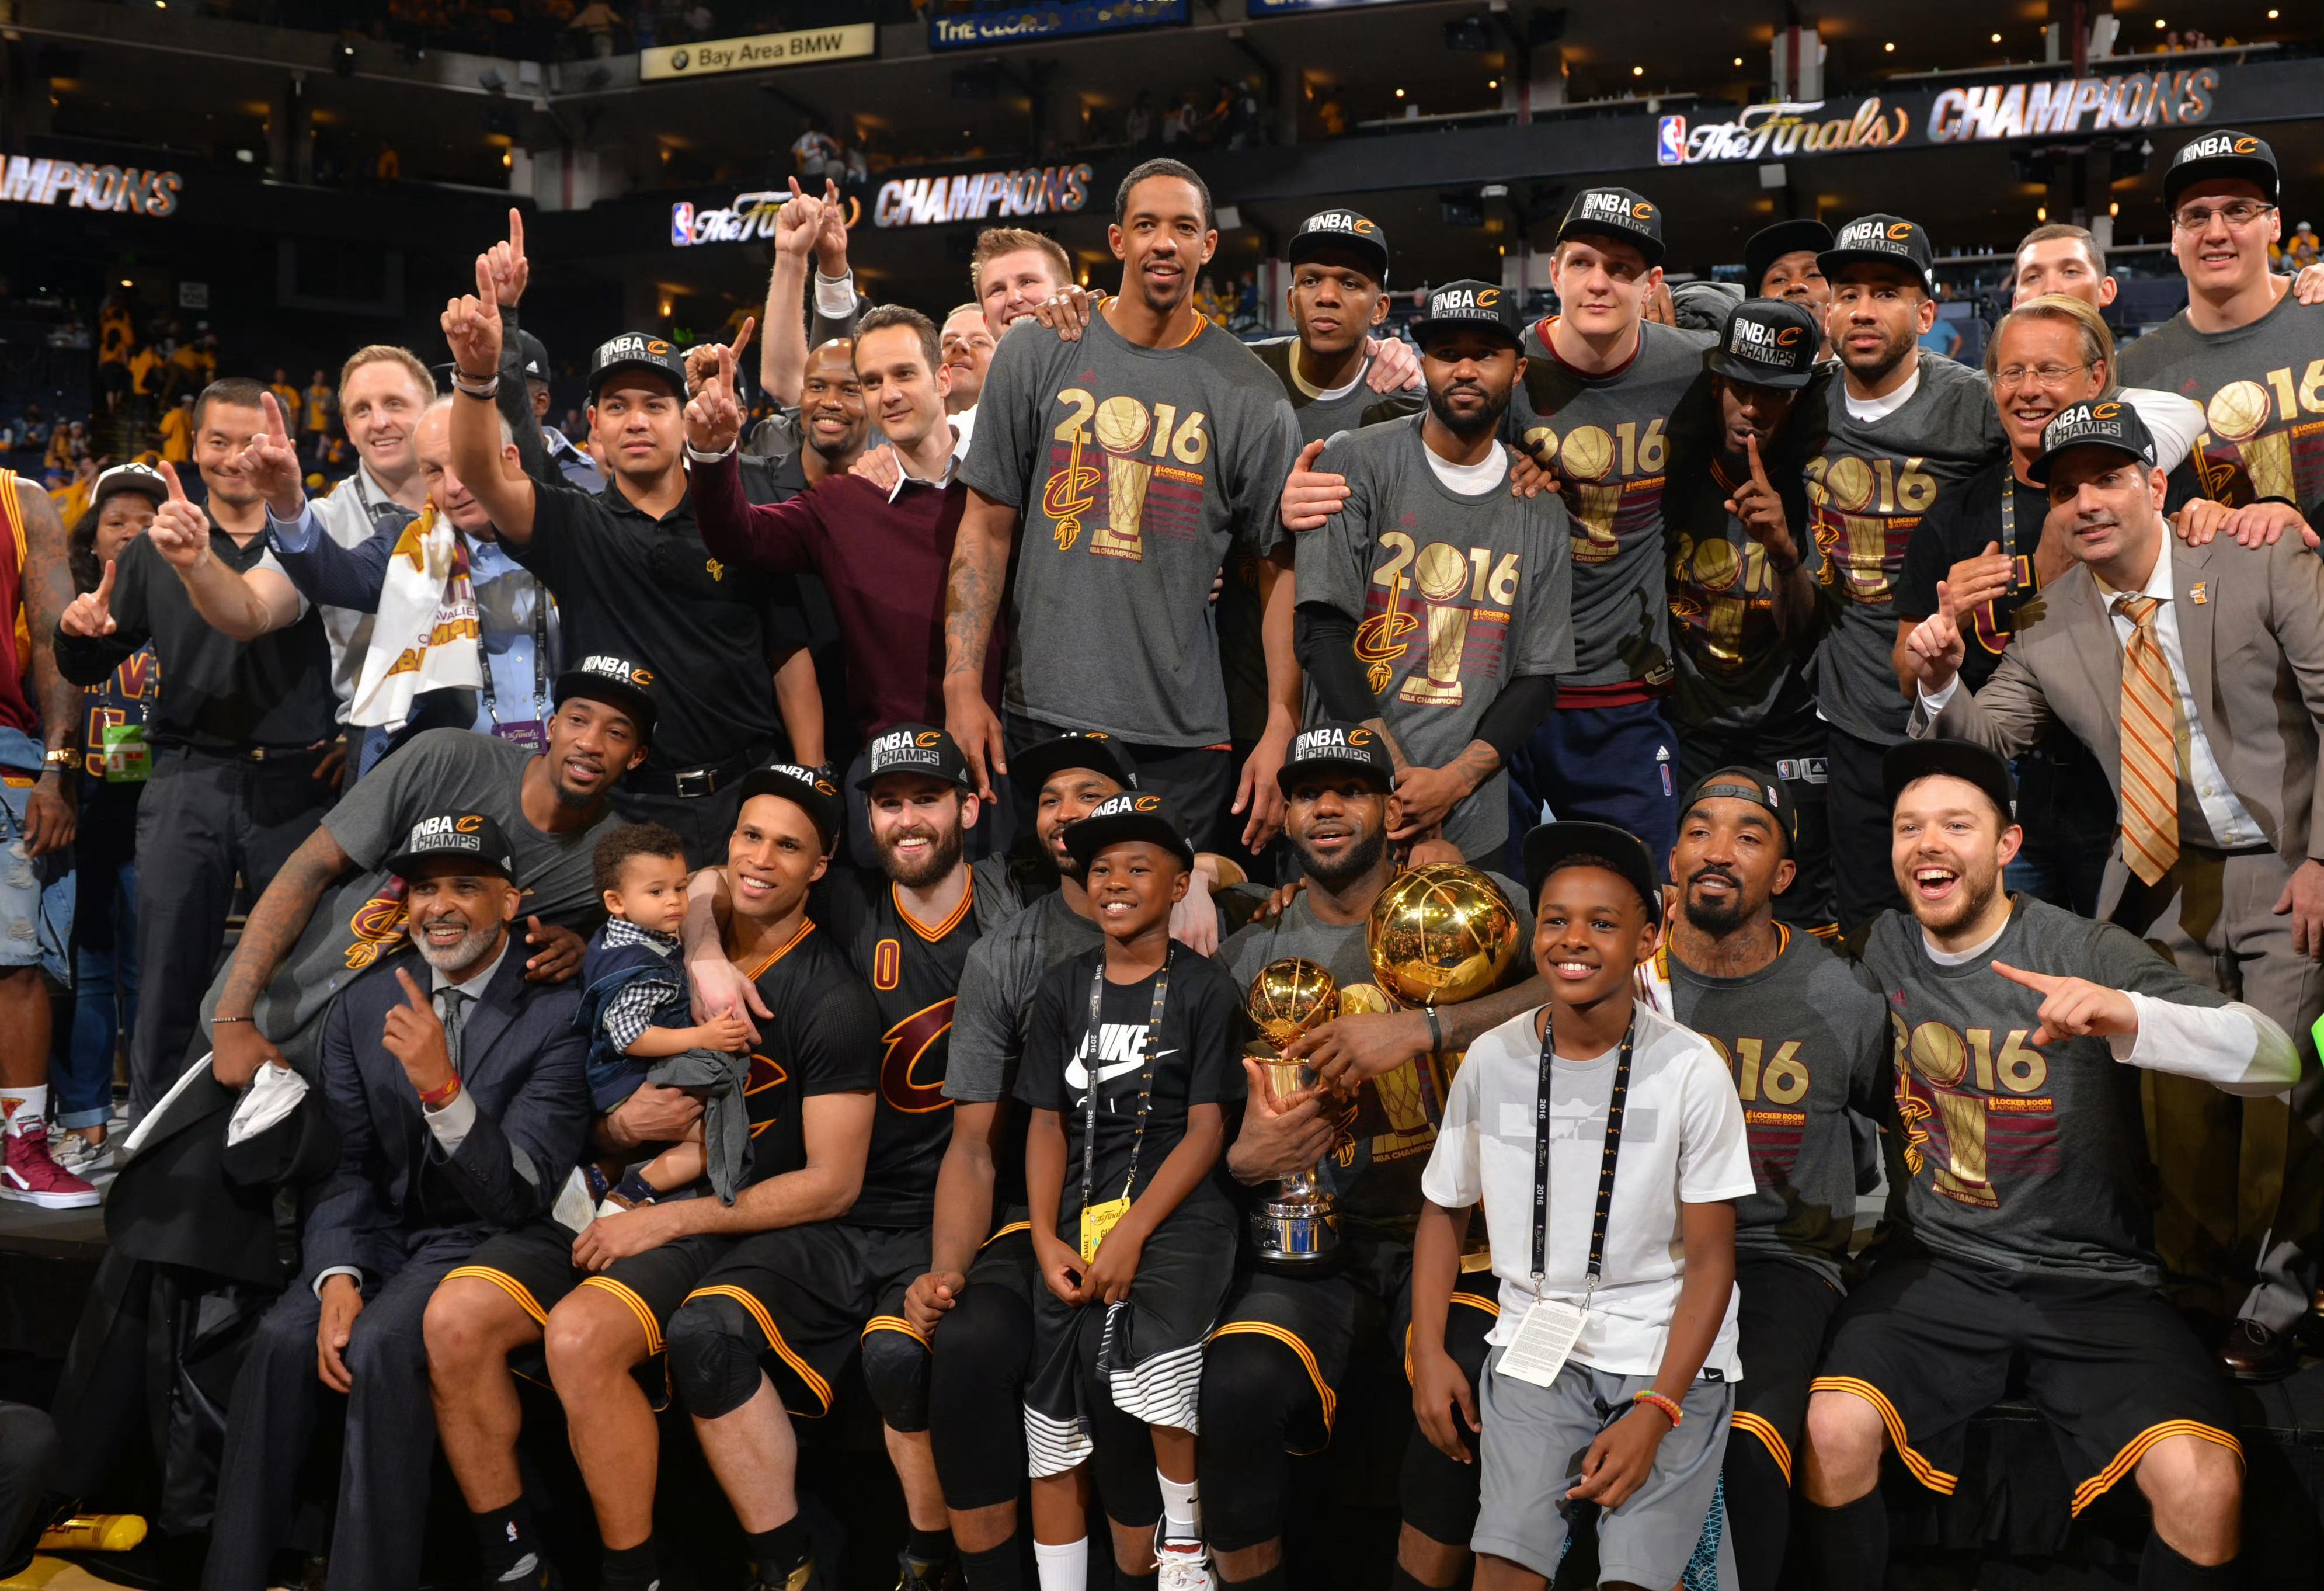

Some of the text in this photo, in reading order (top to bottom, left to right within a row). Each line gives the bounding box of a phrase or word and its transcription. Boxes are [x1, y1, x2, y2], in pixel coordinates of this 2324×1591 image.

[699, 33, 843, 68] Bay Area BMW
[1928, 67, 2219, 143] CHAMPIONS
[1685, 96, 1887, 162] The Finals
[2193, 136, 2233, 160] NBA
[874, 164, 1093, 228] CHAMPIONS
[1594, 193, 1631, 217] NBA
[693, 207, 742, 245] The
[1317, 214, 1352, 231] NBA
[1848, 222, 1885, 242] NBA
[1431, 293, 1441, 319] 201
[1439, 289, 1474, 311] NBA
[610, 337, 645, 353] NBA
[1741, 321, 1776, 348] NBA
[1738, 342, 1797, 369] CHAMPS
[2053, 405, 2092, 433] NBA
[2052, 421, 2121, 447] CHAMPS
[1100, 548, 1142, 562] CHAMPIONS
[1373, 531, 1520, 606] 2016
[592, 655, 630, 678] NBA
[1399, 693, 1462, 706] NBA CHAMPIONS
[879, 731, 914, 753] NBA
[1306, 728, 1345, 749] NBA
[879, 749, 940, 767] CHAMPS
[779, 764, 815, 787] NBA
[1097, 796, 1133, 817] NBA
[418, 815, 453, 838] NBA
[417, 834, 479, 852] CHAMPS
[874, 939, 900, 991] 0
[1094, 964, 1103, 981] 2016
[1079, 1023, 1150, 1062] NIKE
[1752, 1111, 1782, 1120] LOCKER
[1373, 1154, 1391, 1163] NBA
[1536, 1184, 1544, 1205] 2016
[1949, 1191, 1999, 1208] CHAMPIONS
